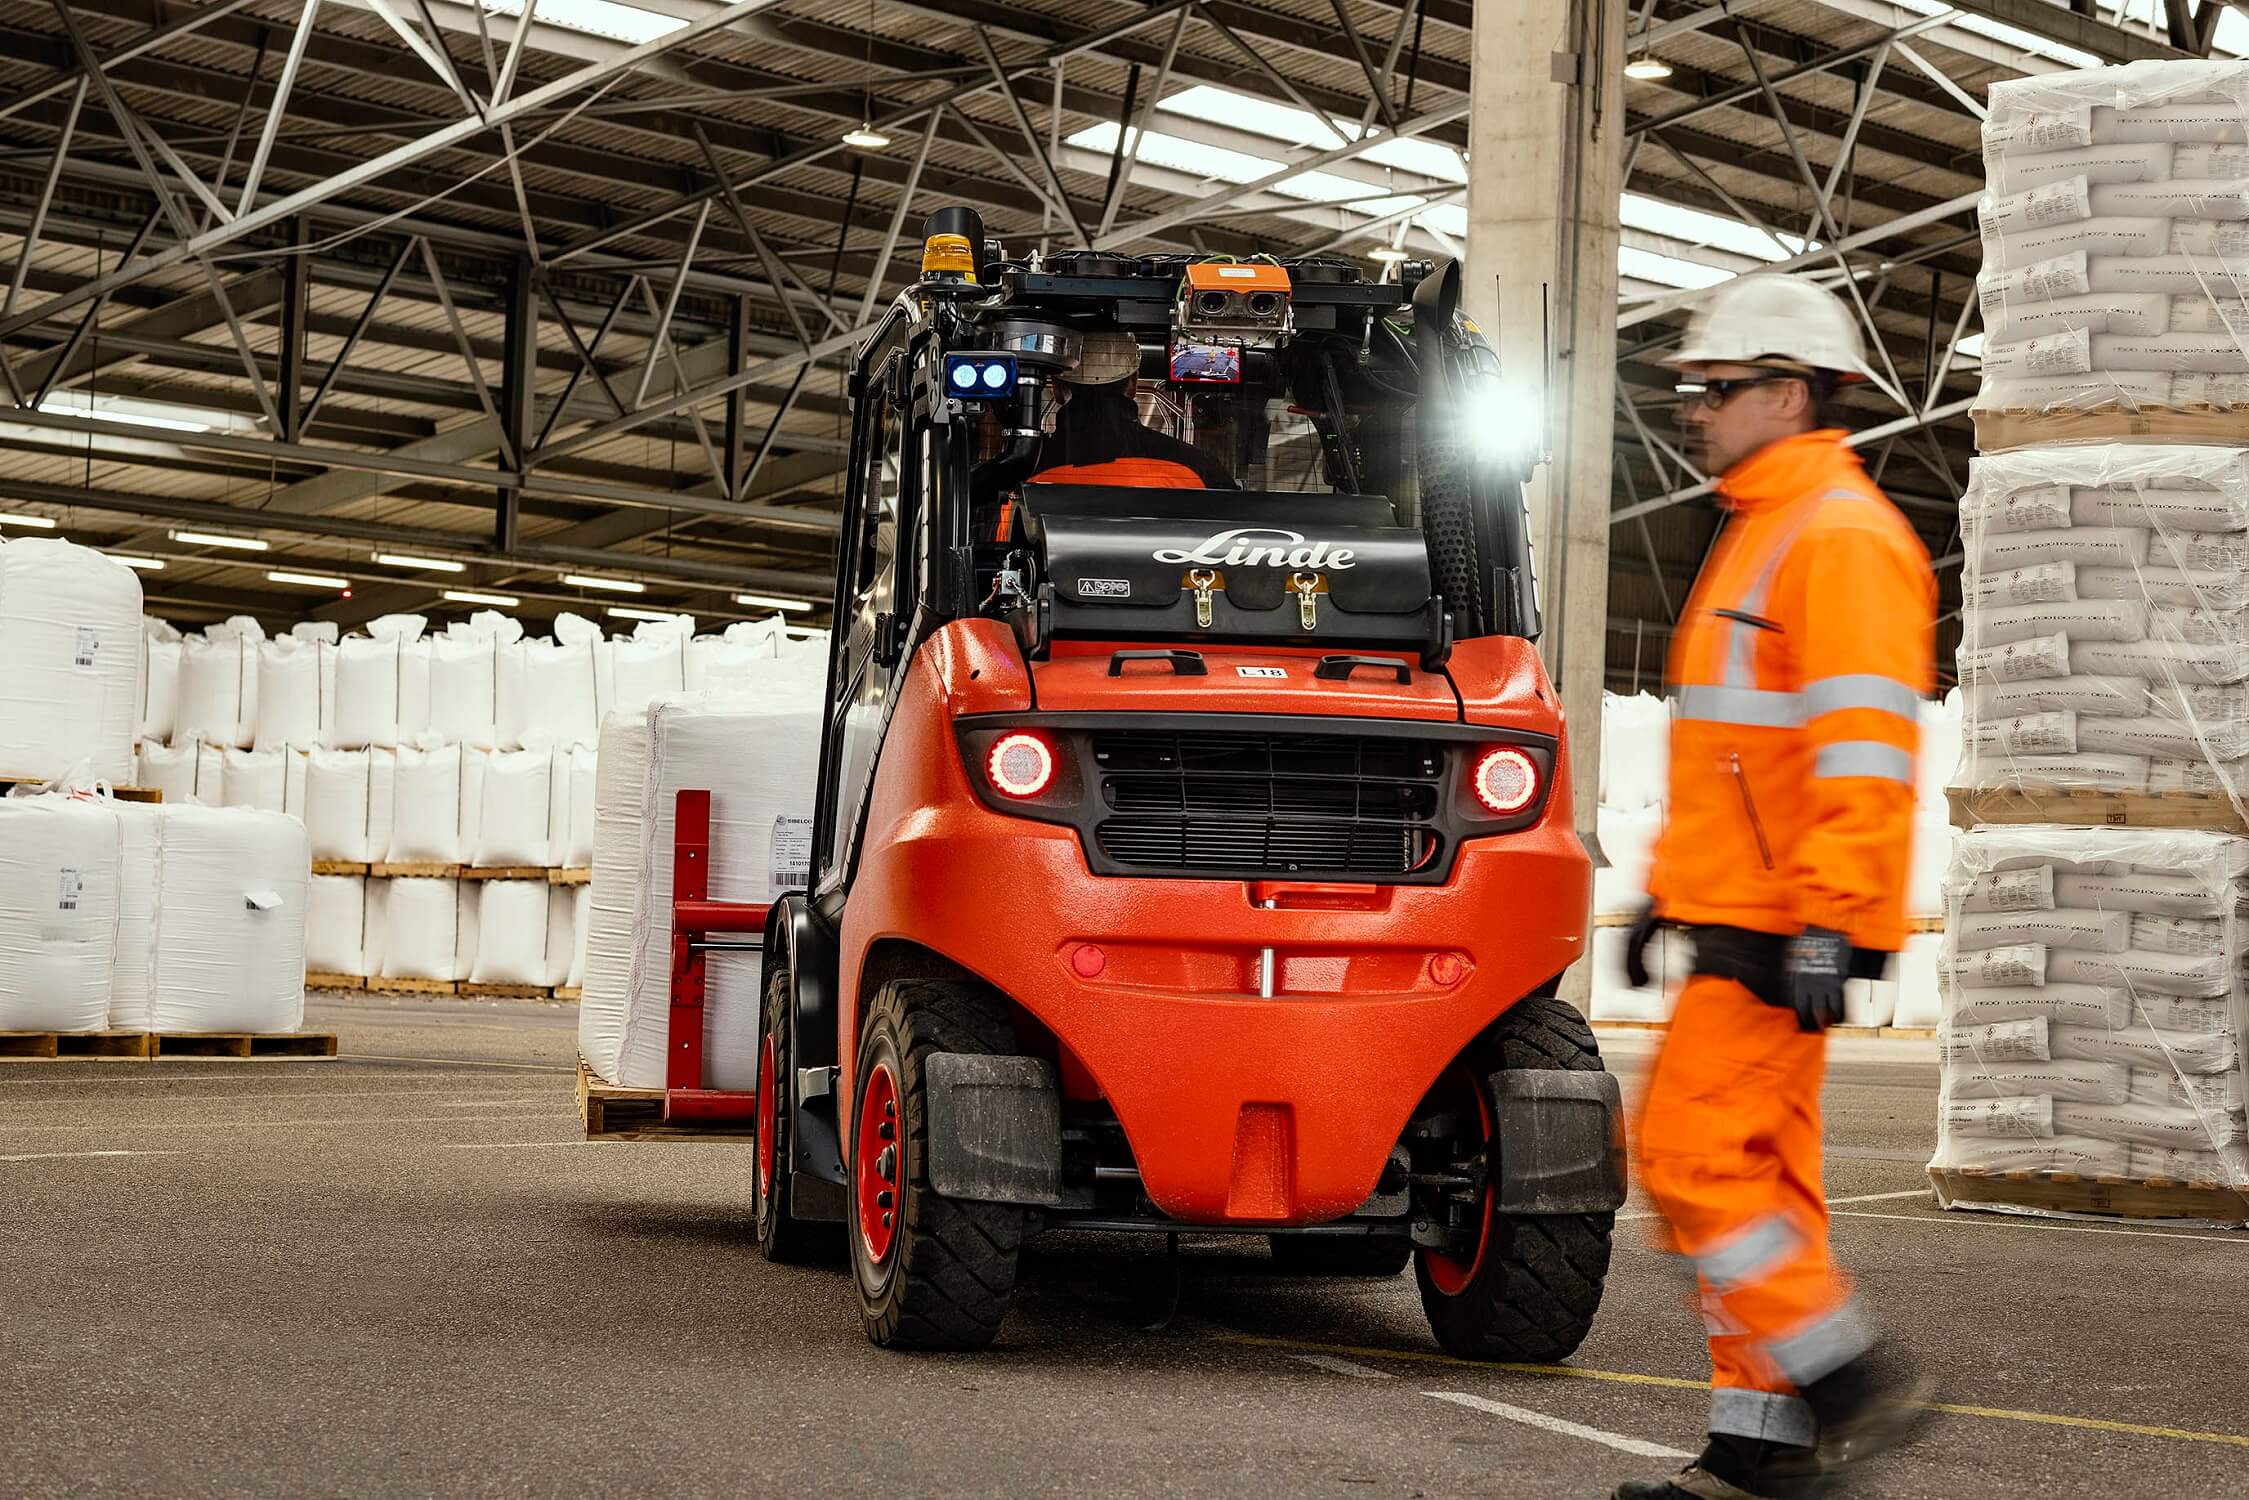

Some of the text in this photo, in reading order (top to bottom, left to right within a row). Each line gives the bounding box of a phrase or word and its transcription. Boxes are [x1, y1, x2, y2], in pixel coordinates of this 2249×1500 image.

[1151, 527, 1357, 571] Linde
[1240, 668, 1283, 677] L18
[786, 817, 813, 825] SIBELCO
[1949, 1104, 1977, 1112] SIBELCO
